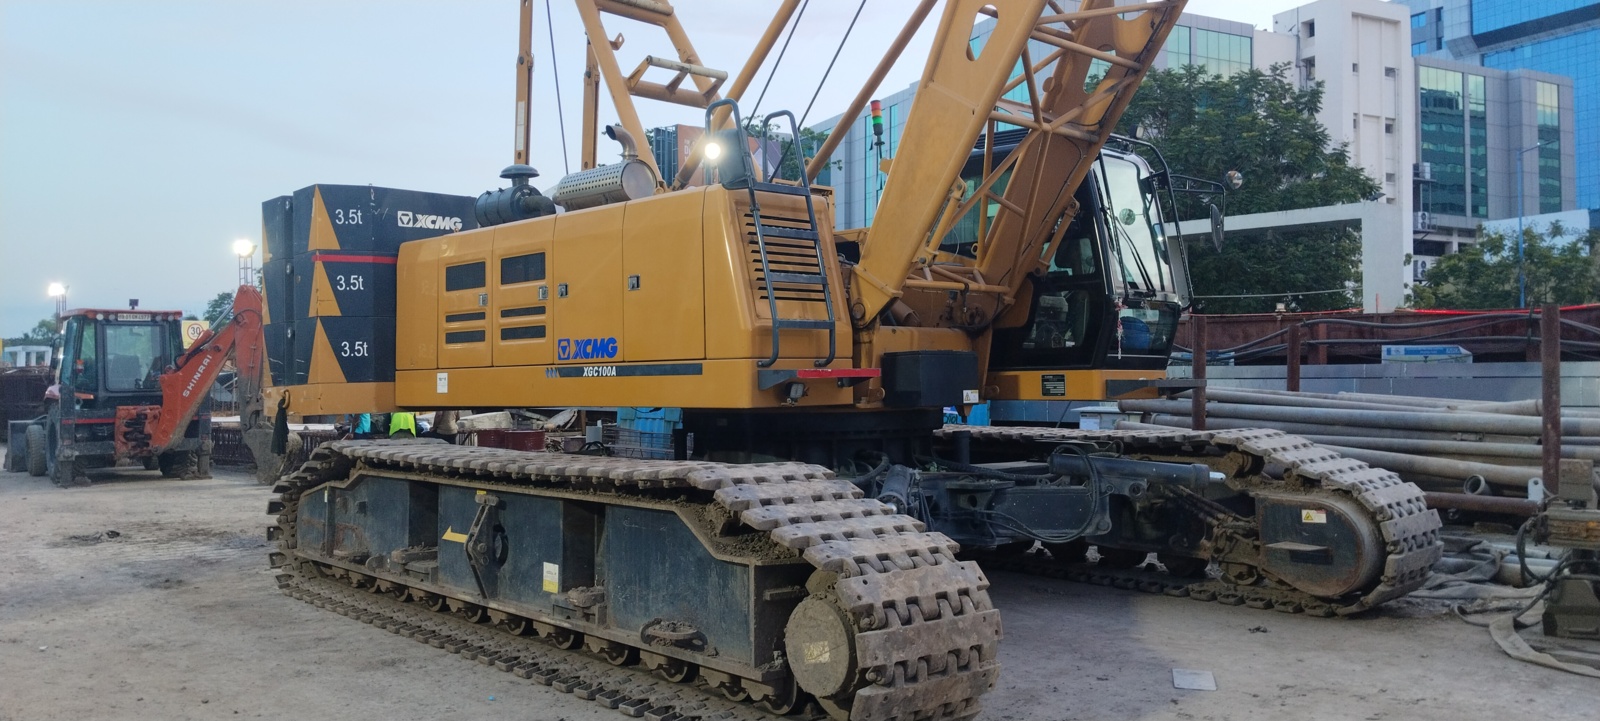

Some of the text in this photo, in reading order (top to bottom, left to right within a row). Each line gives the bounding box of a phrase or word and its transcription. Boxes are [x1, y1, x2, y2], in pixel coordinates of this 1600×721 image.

[335, 209, 363, 225] 3.5t
[413, 213, 463, 231] XCMG
[336, 275, 364, 291] 3.5t
[190, 326, 201, 336] 30
[341, 341, 369, 357] 3.5t
[571, 337, 618, 359] XCMG
[182, 354, 212, 397] SHINRAI
[582, 366, 617, 377] XGC100A
